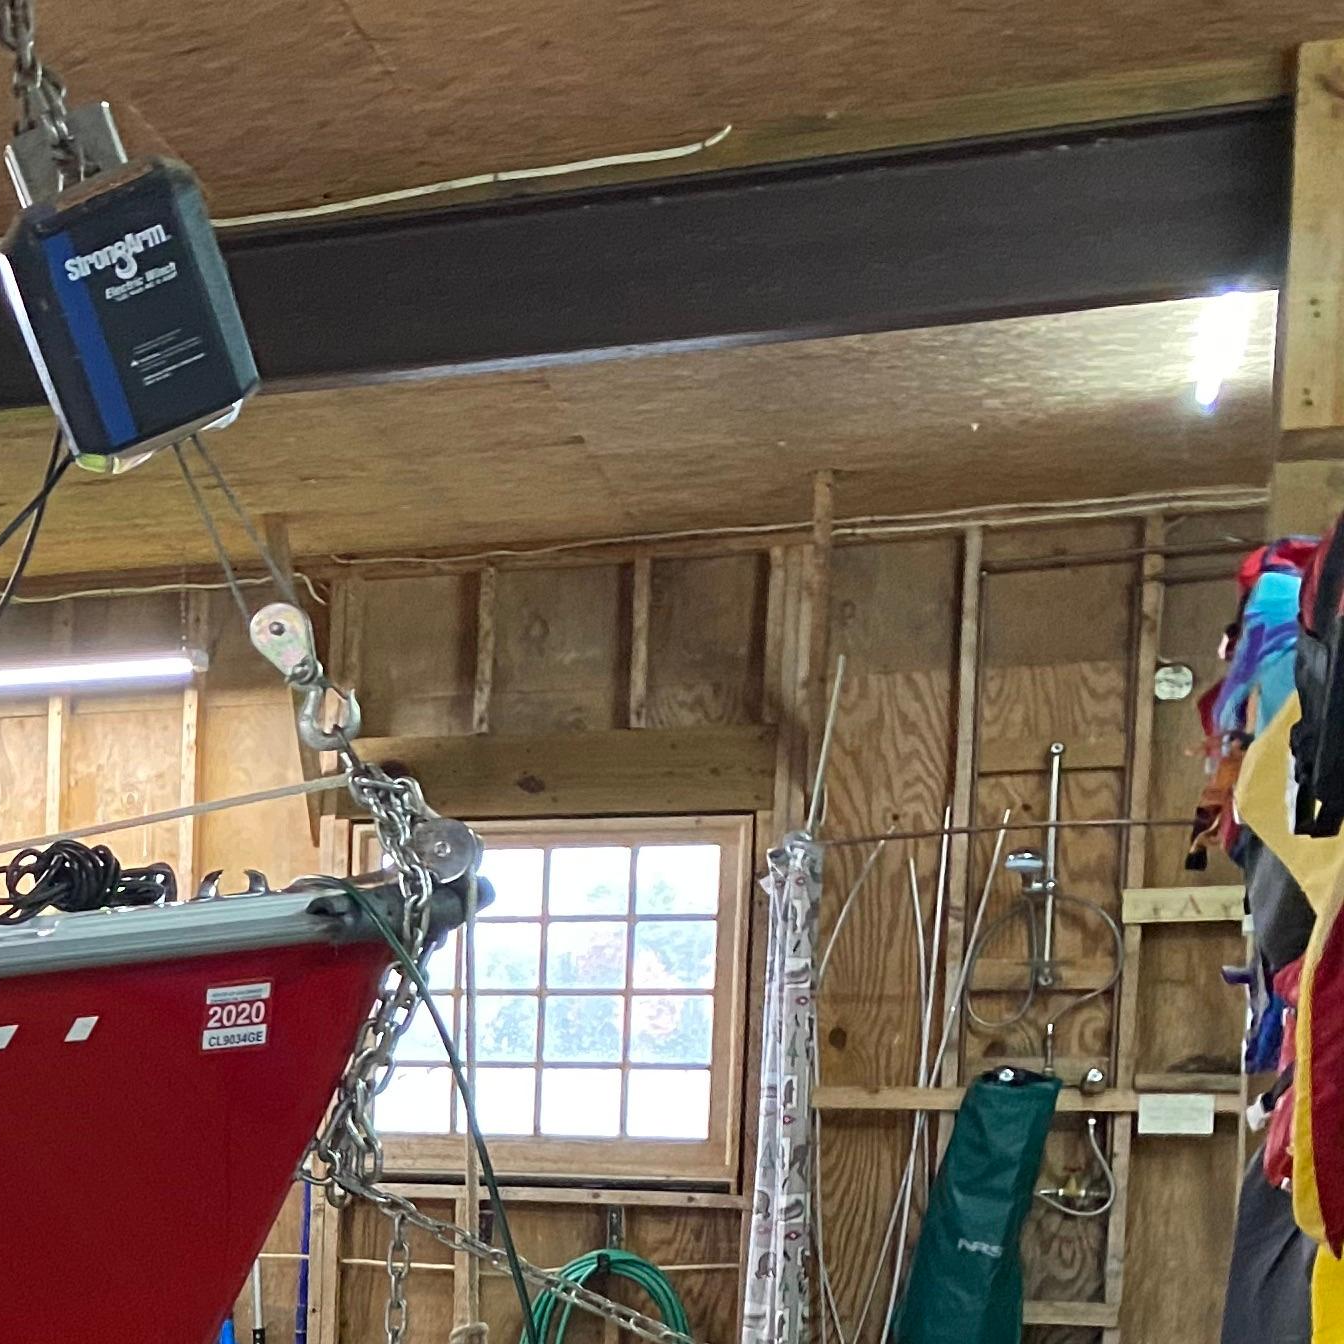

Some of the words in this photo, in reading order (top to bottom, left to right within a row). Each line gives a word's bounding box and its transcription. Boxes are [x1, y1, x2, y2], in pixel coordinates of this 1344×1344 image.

[64, 223, 168, 281] StrongArm
[207, 1001, 266, 1028] 2020
[957, 1237, 1004, 1258] NRS
